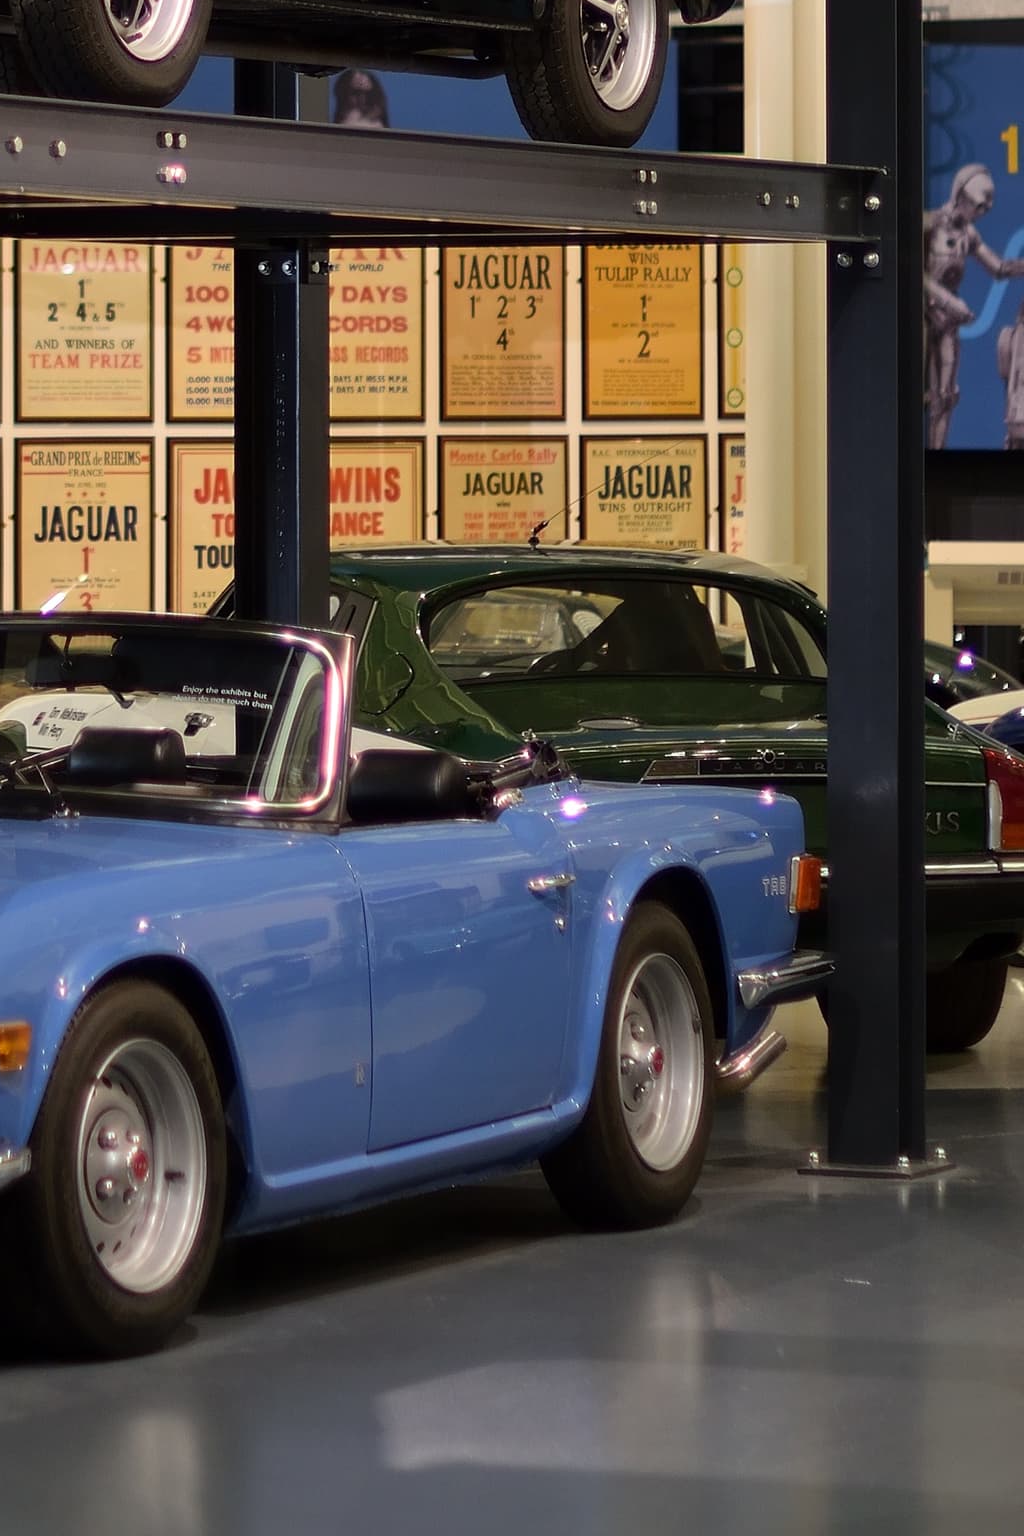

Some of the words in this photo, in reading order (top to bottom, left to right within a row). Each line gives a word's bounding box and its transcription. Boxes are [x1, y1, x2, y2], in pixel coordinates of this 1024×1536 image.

[29, 246, 141, 273] JAGUAR
[628, 252, 660, 265] WINS
[211, 263, 231, 272] THE
[348, 263, 384, 272] WORLD
[453, 254, 552, 290] JAGUAR
[594, 266, 639, 282] TULIP
[643, 266, 692, 282] RALLY
[185, 285, 229, 303] 100
[342, 285, 409, 303] DAYS
[185, 315, 202, 333] 4
[34, 339, 59, 350] AND
[65, 339, 115, 350] WINNERS
[121, 339, 135, 350] OF
[28, 353, 80, 369] TEAM
[89, 353, 143, 369] PRIZE
[186, 346, 202, 363] 5
[354, 346, 409, 363] RECORDS
[354, 375, 363, 383] AT
[357, 386, 365, 394] AT
[31, 450, 67, 466] GRAND
[68, 450, 93, 466] PRIX
[104, 450, 141, 466] RHEIMS
[450, 449, 487, 463] Monte
[492, 448, 523, 462] Carlo
[528, 447, 558, 465] Rally
[68, 468, 105, 478] FRANCE
[330, 466, 401, 504] WINS
[462, 471, 545, 496] JAGUAR
[597, 464, 692, 501] JAGUAR
[598, 503, 627, 514] WINS
[632, 502, 692, 513] OUTRIGHT
[34, 505, 138, 543] JAGUAR
[182, 684, 204, 695] Enjoy
[206, 686, 219, 694] the
[221, 688, 252, 697] exhibits
[253, 691, 268, 700] but
[198, 695, 209, 703] do
[226, 698, 250, 707] touch
[251, 700, 274, 711] them
[713, 761, 826, 773] JAGUAR
